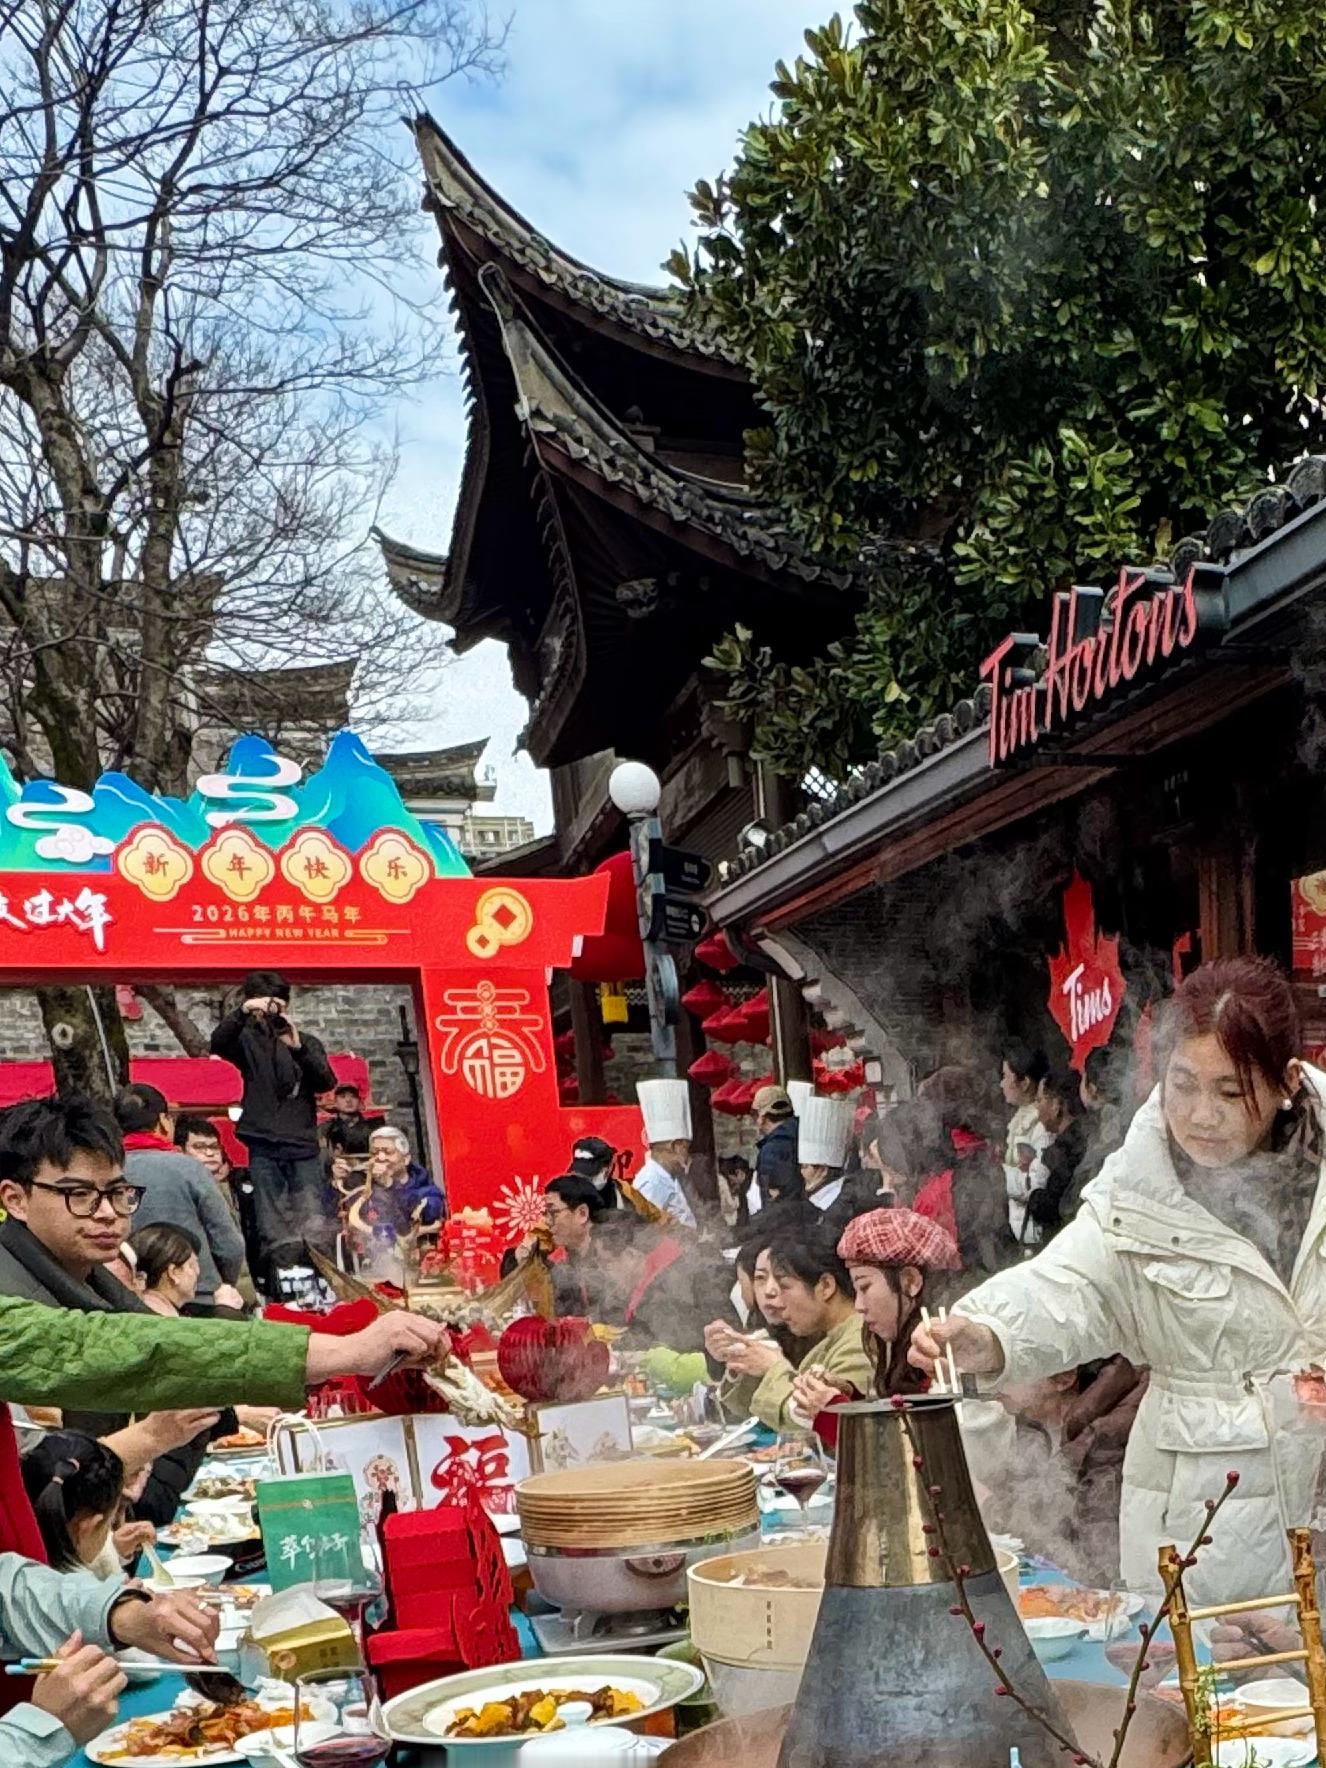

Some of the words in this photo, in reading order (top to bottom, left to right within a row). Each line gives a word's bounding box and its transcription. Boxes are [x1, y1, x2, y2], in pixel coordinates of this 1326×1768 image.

[979, 633, 1038, 769] Tim
[1045, 563, 1198, 732] Hortons
[143, 851, 407, 880] 新年快乐
[0, 886, 113, 950] 过大年
[191, 904, 361, 924] 2026年丙午马年
[229, 928, 272, 938] HAPPY
[275, 928, 303, 938] NEW
[307, 928, 340, 938] YEAR
[1062, 963, 1112, 1042] Tims
